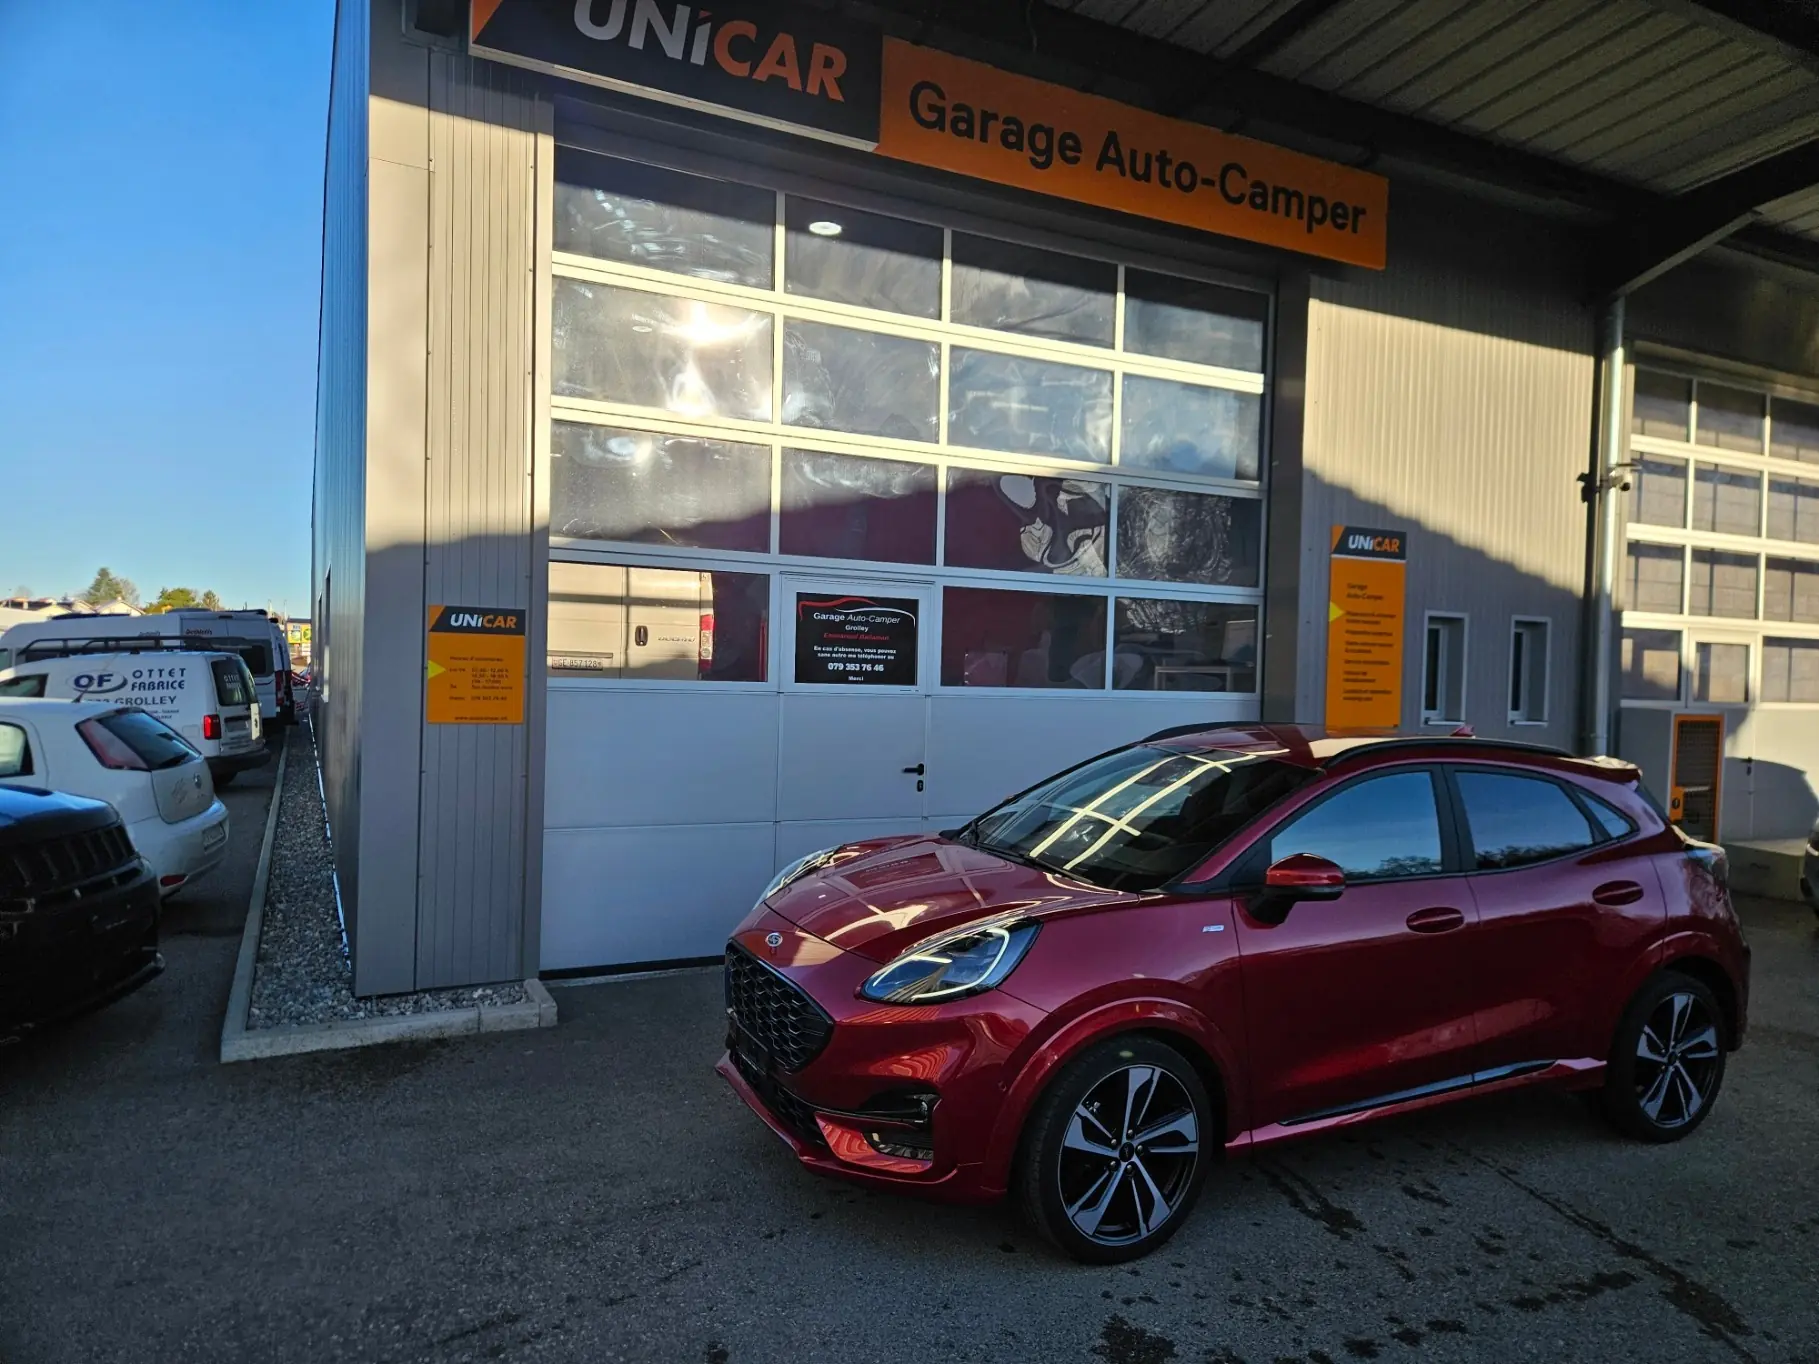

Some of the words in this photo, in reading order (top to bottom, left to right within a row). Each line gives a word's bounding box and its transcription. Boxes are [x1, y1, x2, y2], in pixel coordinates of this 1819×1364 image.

[909, 79, 1082, 170] Garage
[1095, 129, 1368, 235] Auto-Camper
[814, 612, 845, 622] Garage
[846, 614, 900, 624] Auto-Camper
[132, 668, 187, 679] OTTET
[74, 673, 113, 688] OF
[131, 679, 186, 692] FABRICE
[114, 695, 177, 706] GROLLEY
